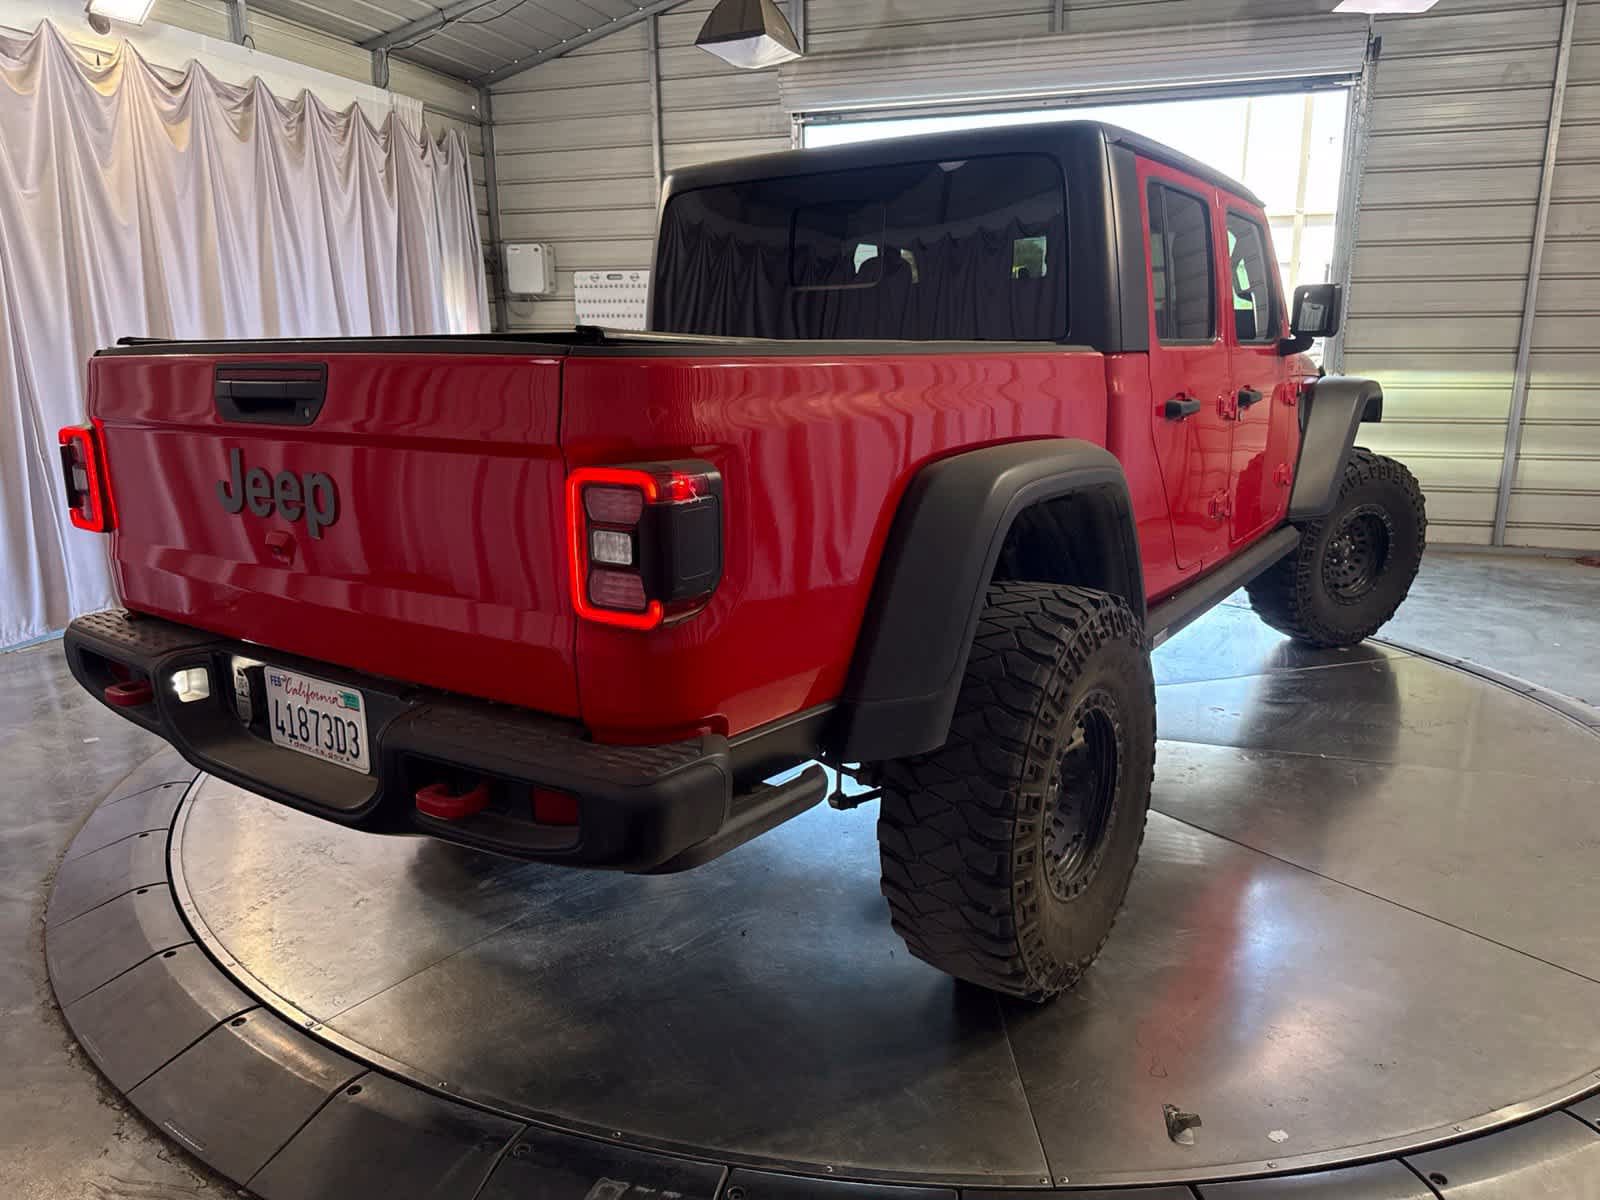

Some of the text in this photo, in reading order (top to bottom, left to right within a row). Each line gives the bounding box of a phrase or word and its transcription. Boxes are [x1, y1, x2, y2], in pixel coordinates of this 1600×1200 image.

[216, 447, 339, 540] Jeep
[284, 676, 340, 706] California
[275, 699, 360, 759] 41873D3
